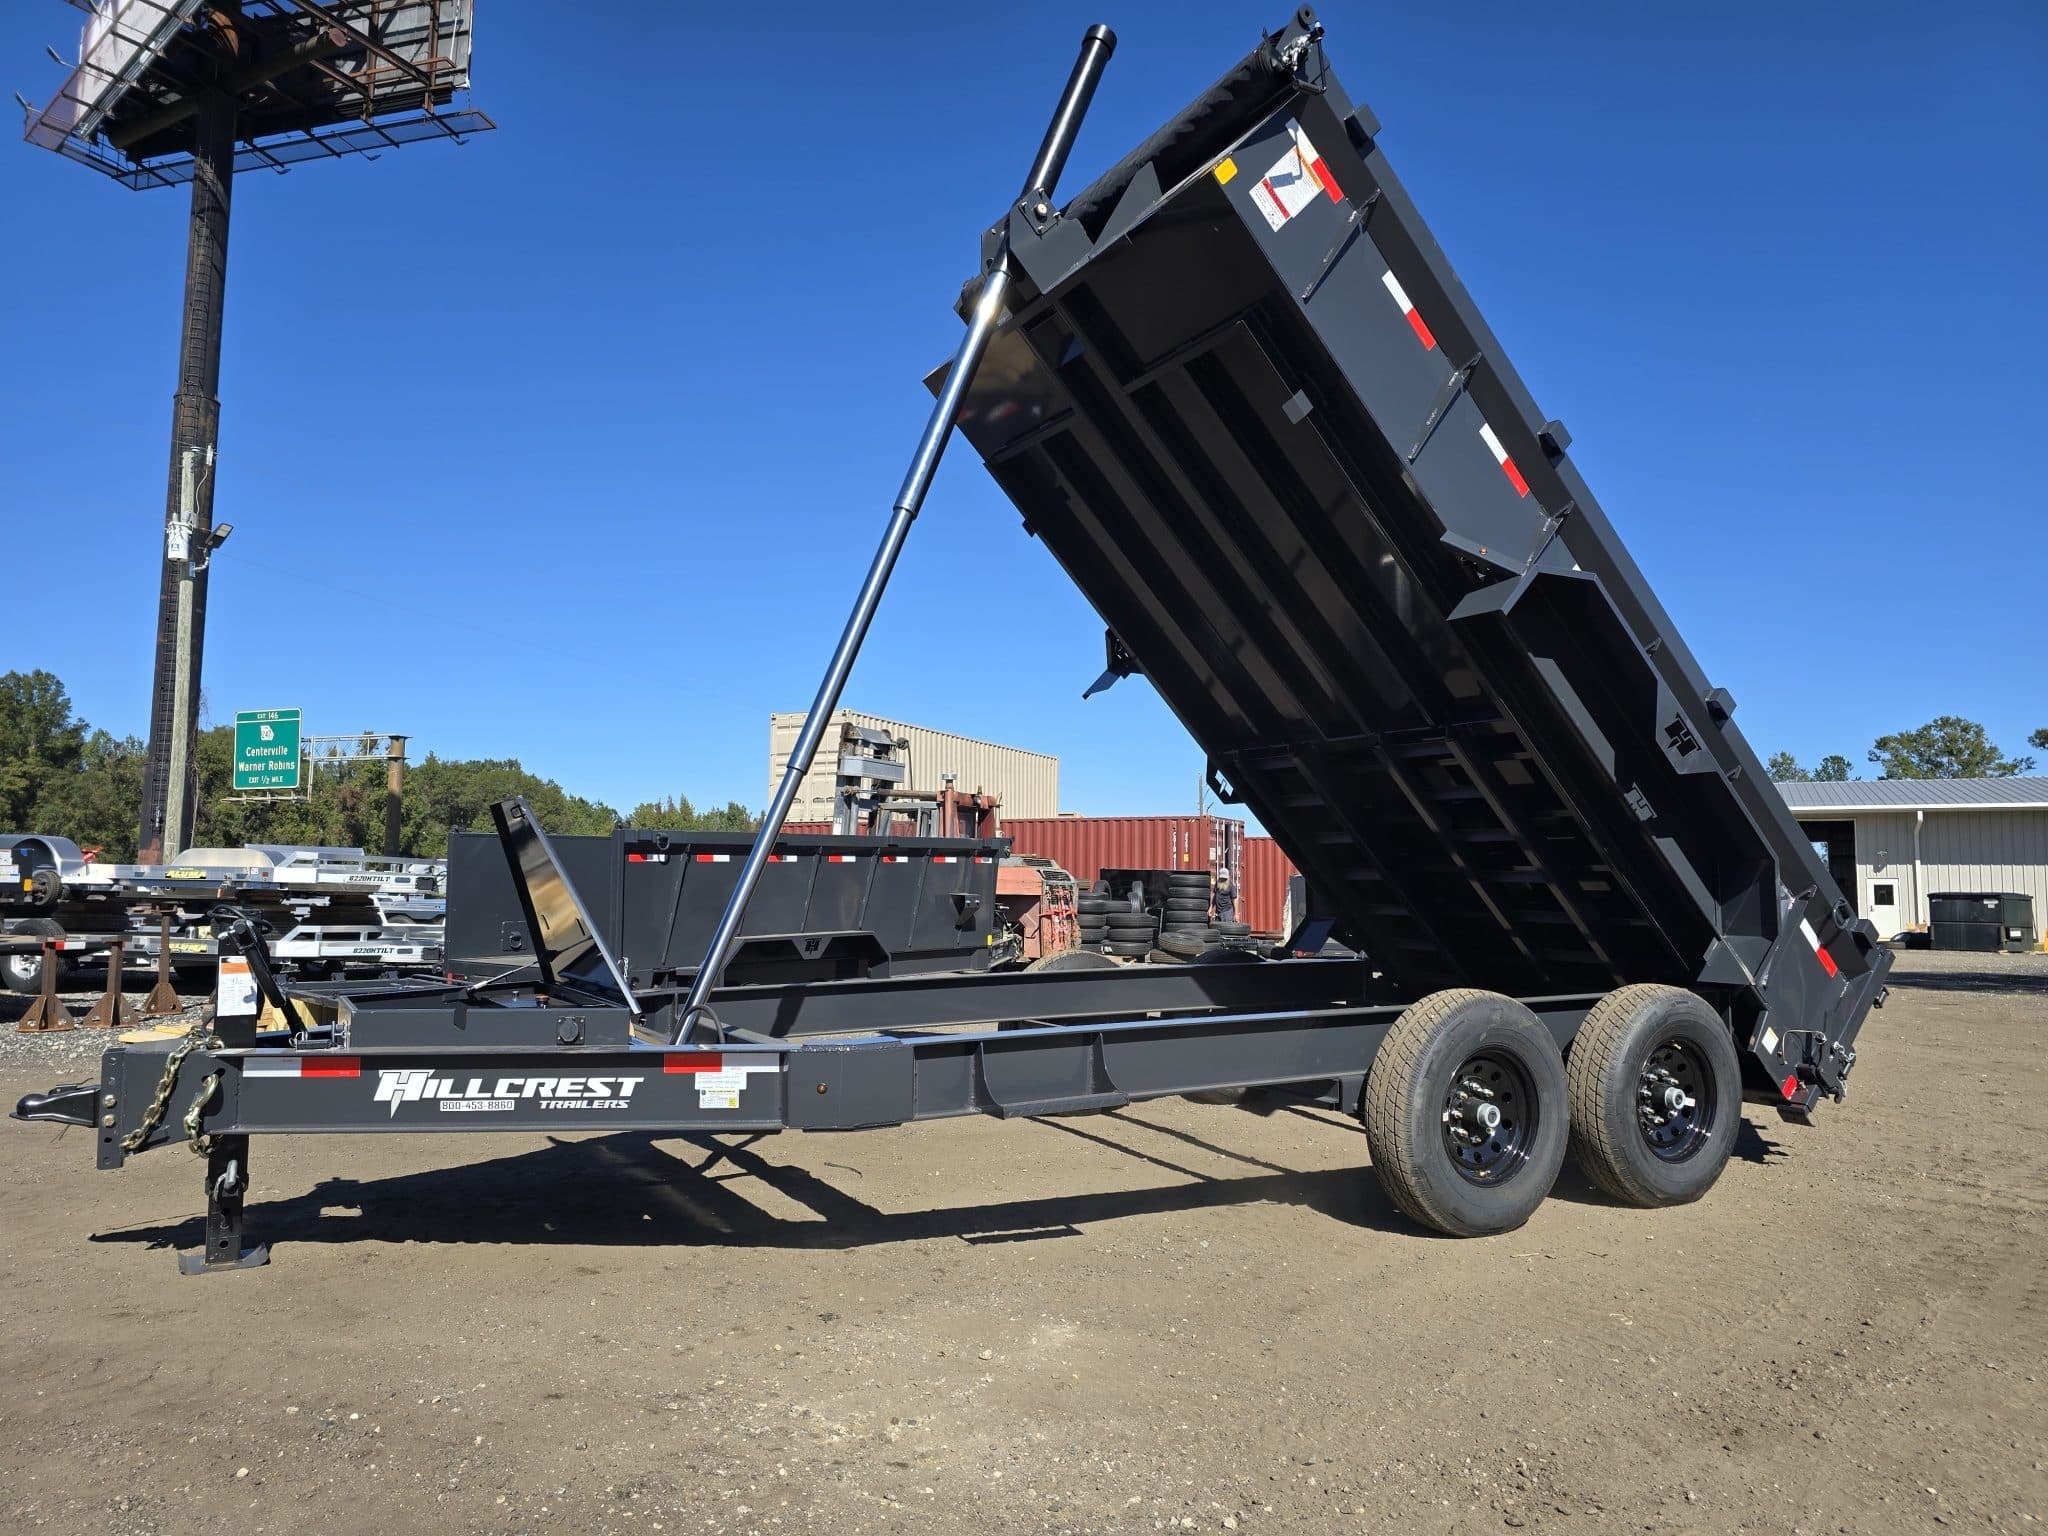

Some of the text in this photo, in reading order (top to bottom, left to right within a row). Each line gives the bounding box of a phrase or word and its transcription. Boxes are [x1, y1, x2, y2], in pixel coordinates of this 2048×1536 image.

[246, 745, 288, 757] Centerville
[238, 761, 295, 772] Warner Robins
[248, 776, 259, 784] EXIT
[373, 1069, 645, 1119] HILLCREST
[442, 1100, 631, 1110] 800-453-8860 TRAILERS
